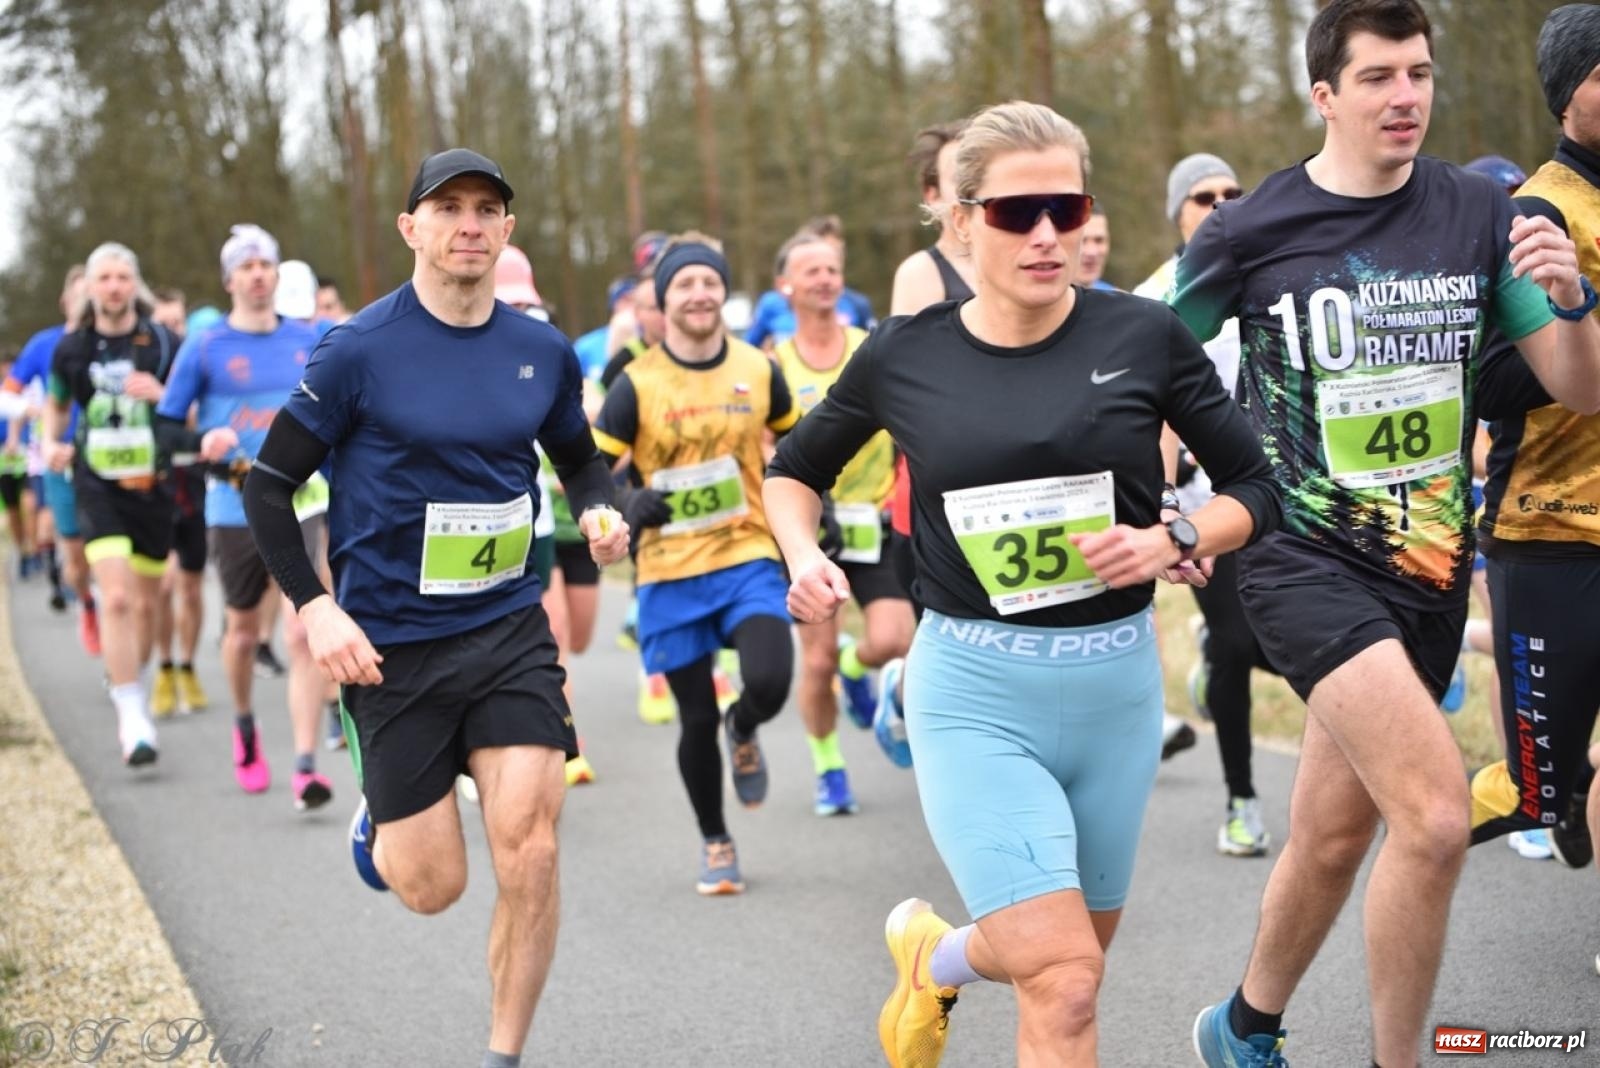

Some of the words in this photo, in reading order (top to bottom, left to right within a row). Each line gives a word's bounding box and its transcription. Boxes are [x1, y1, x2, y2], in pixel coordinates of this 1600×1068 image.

[1358, 272, 1477, 307] KUŹNIAŃSKI
[1267, 287, 1357, 372] 10
[1363, 310, 1445, 330] PÓŁMARATON
[1446, 305, 1479, 325] LEŚNY
[1364, 329, 1477, 368] RAFAMET
[1365, 410, 1431, 463] 48
[682, 486, 722, 517] 63
[470, 537, 497, 574] 4
[993, 526, 1069, 588] 35
[939, 617, 1044, 656] NIKE
[1049, 624, 1139, 658] PRO
[1530, 637, 1556, 824] BOLATICE
